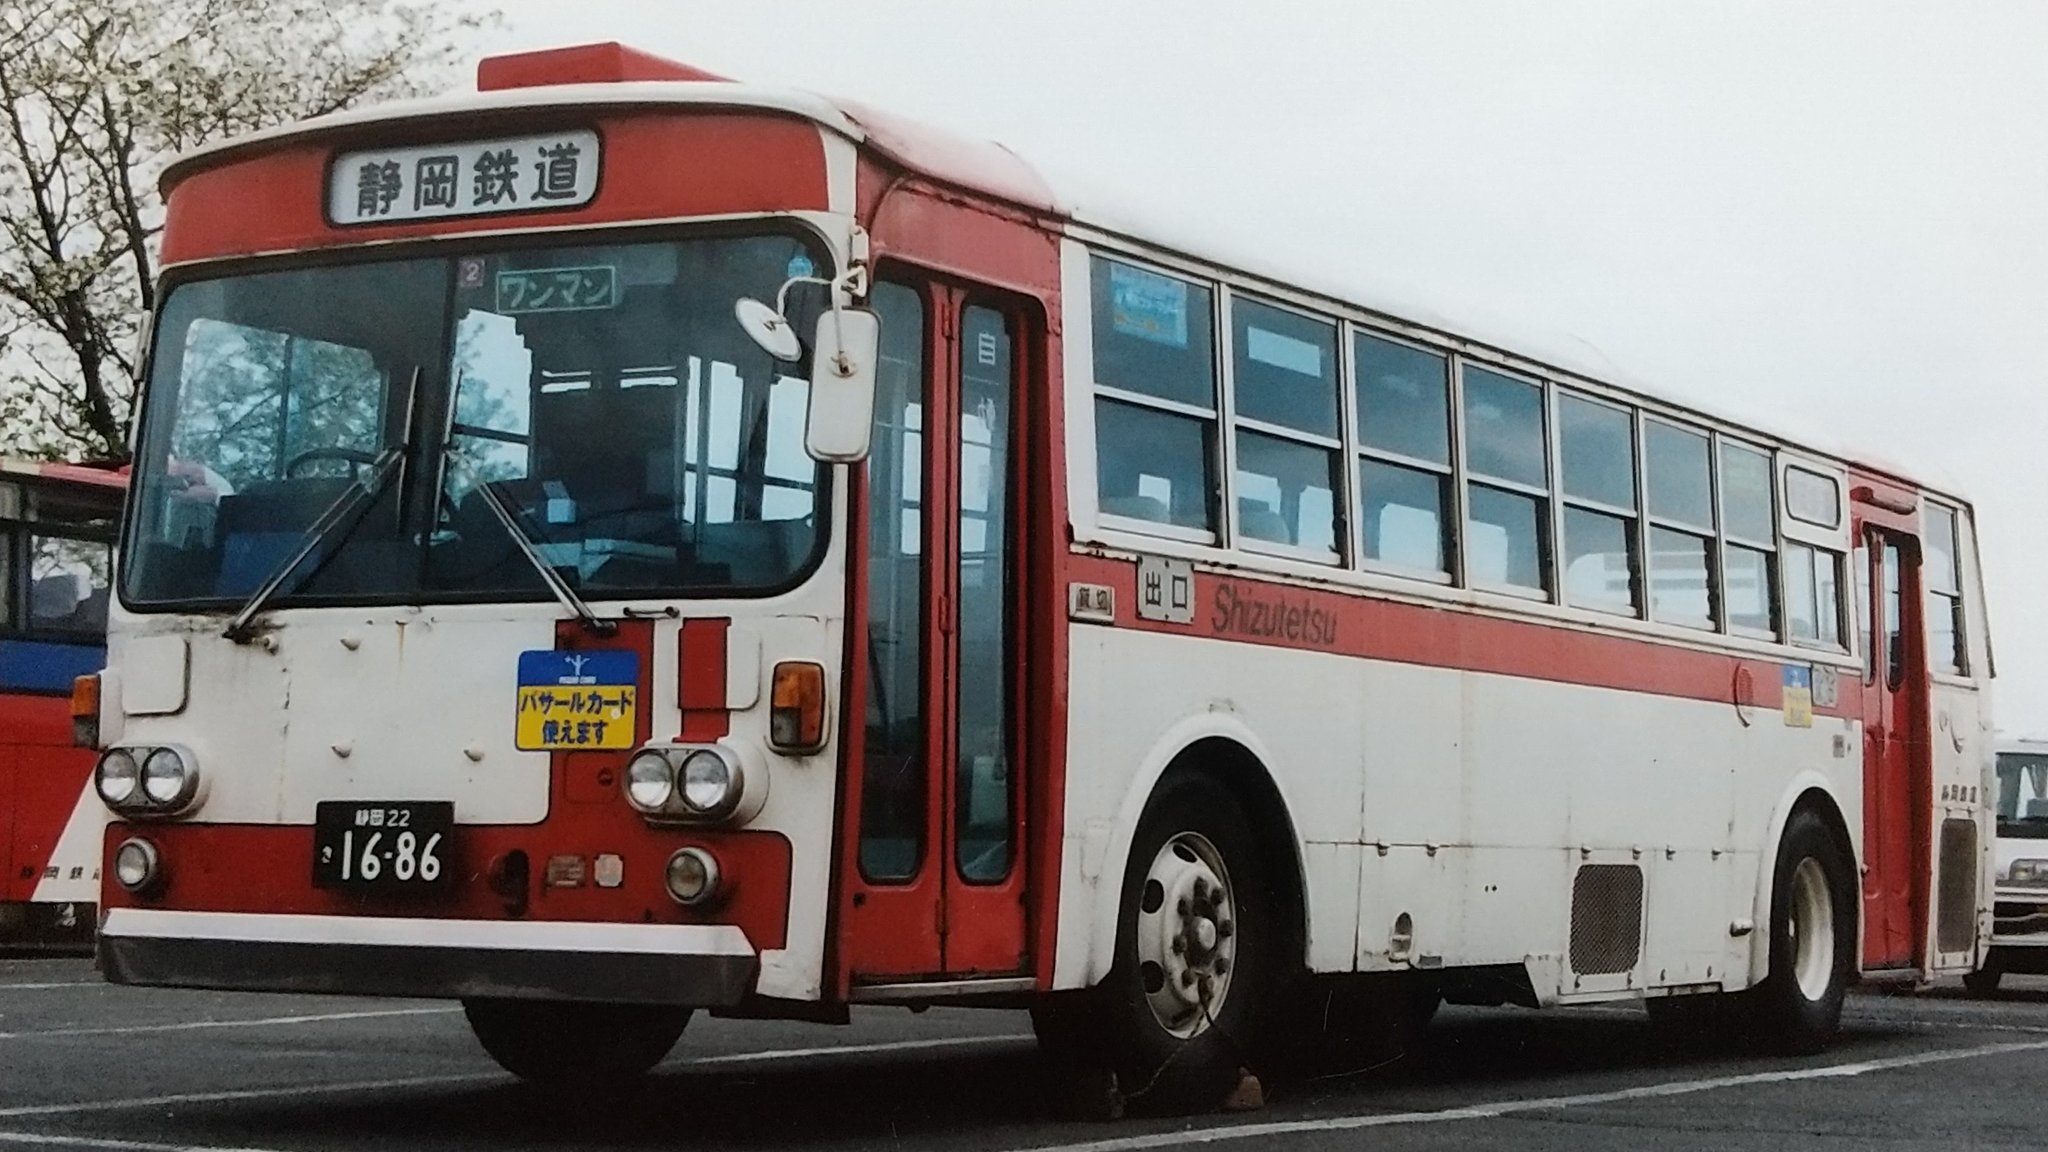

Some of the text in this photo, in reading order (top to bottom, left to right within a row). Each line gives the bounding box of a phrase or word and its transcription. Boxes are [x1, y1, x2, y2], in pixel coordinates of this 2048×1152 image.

[357, 143, 581, 217] 静岡鉄道
[466, 263, 479, 282] 2
[500, 273, 612, 309] ワンマン
[1145, 571, 1188, 609] 出口
[1211, 583, 1337, 645] Shizutetsu
[543, 719, 609, 744] 使えます
[341, 830, 442, 882] 16-86
